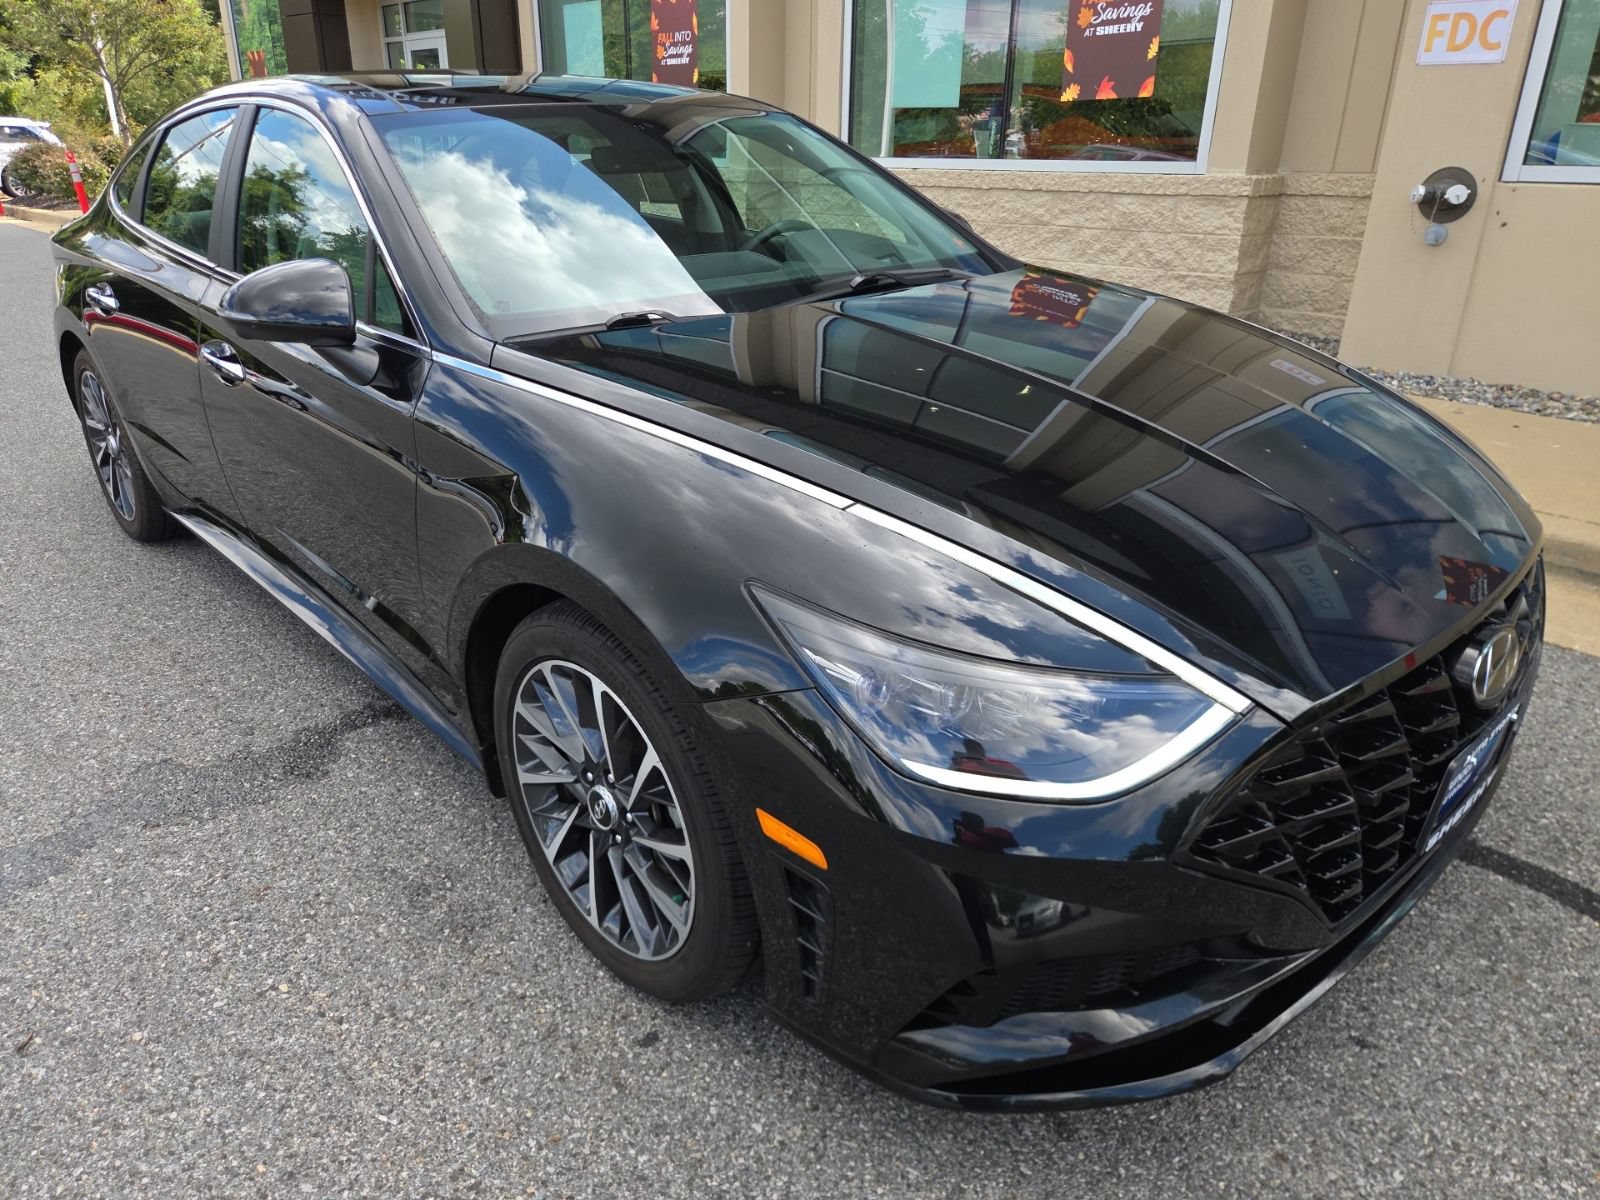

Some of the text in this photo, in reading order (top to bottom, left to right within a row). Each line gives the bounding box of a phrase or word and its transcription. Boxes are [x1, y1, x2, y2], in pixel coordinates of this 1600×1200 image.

[1091, 2, 1155, 24] Savings
[658, 31, 692, 44] FALL INTO
[1084, 22, 1144, 37] AT SHEEHY
[1424, 9, 1509, 52] FDC
